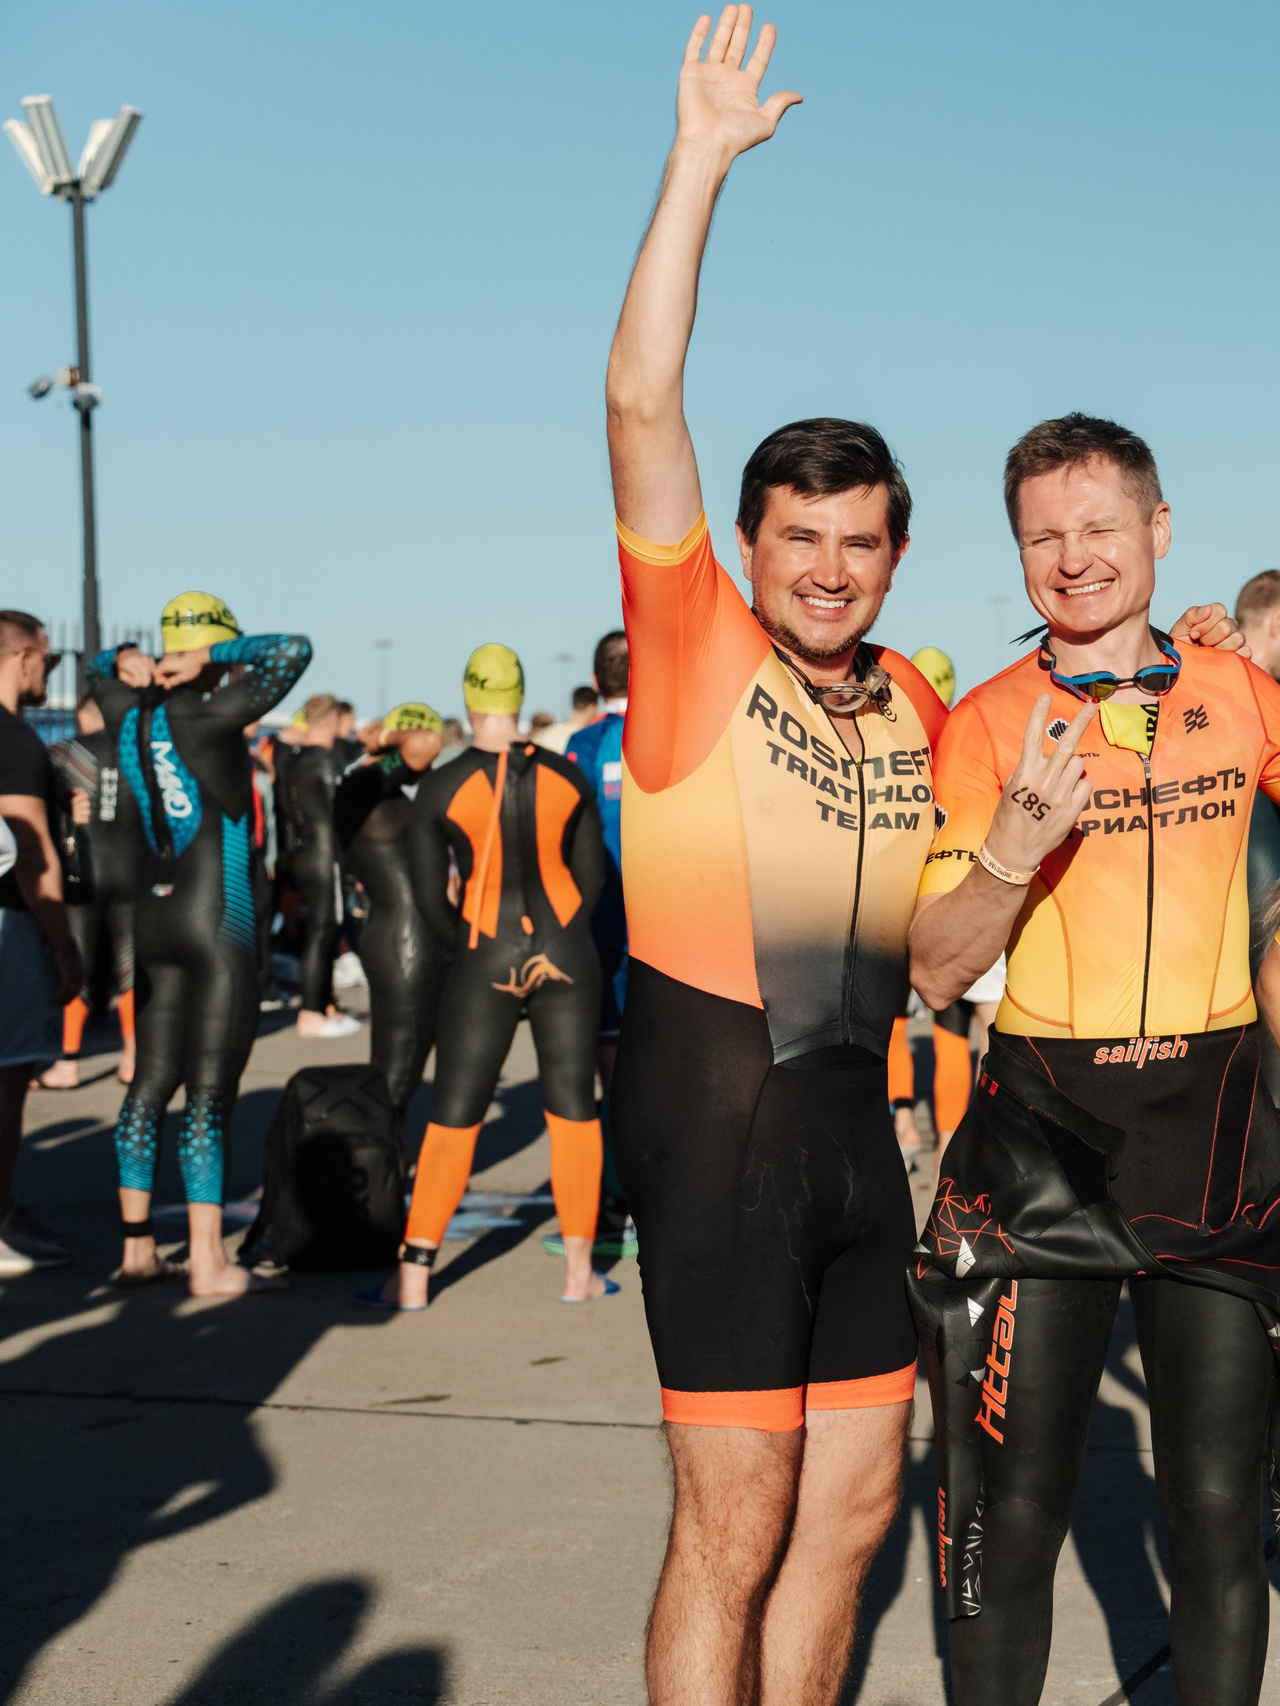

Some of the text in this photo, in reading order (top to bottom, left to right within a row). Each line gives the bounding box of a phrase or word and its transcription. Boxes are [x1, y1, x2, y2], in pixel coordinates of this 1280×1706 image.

[766, 741, 935, 804] TRIATHLO
[1083, 767, 1246, 811] СНЕФТЬ
[816, 799, 920, 831] TEAM
[1011, 787, 1051, 821] 587
[1093, 1035, 1188, 1069] sailfish
